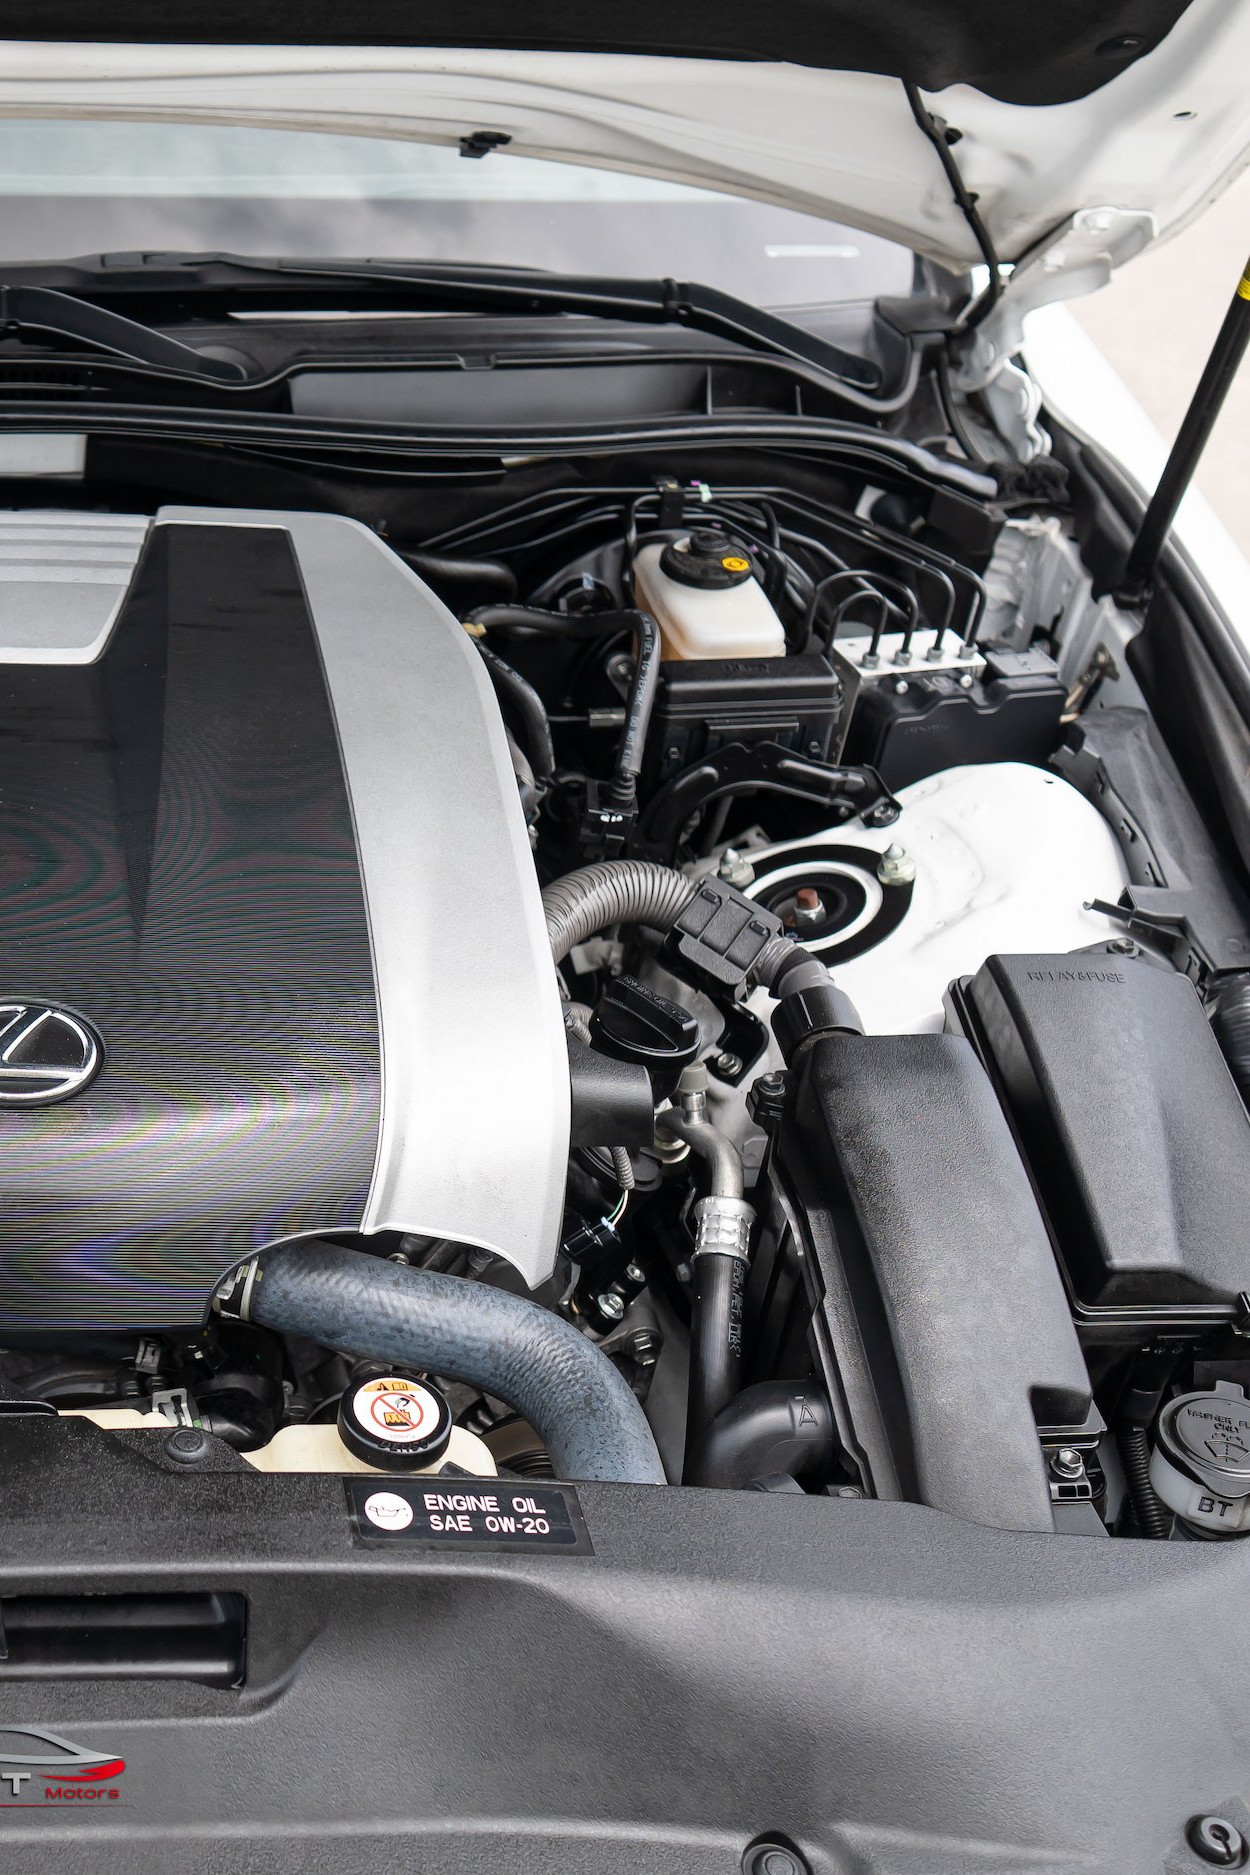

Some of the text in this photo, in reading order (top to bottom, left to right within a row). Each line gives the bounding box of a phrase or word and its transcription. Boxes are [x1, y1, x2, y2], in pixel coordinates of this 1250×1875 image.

[422, 1493, 547, 1515] ENGINE OIL
[1197, 1495, 1234, 1517] BT
[428, 1514, 551, 1535] SAE 0W-20
